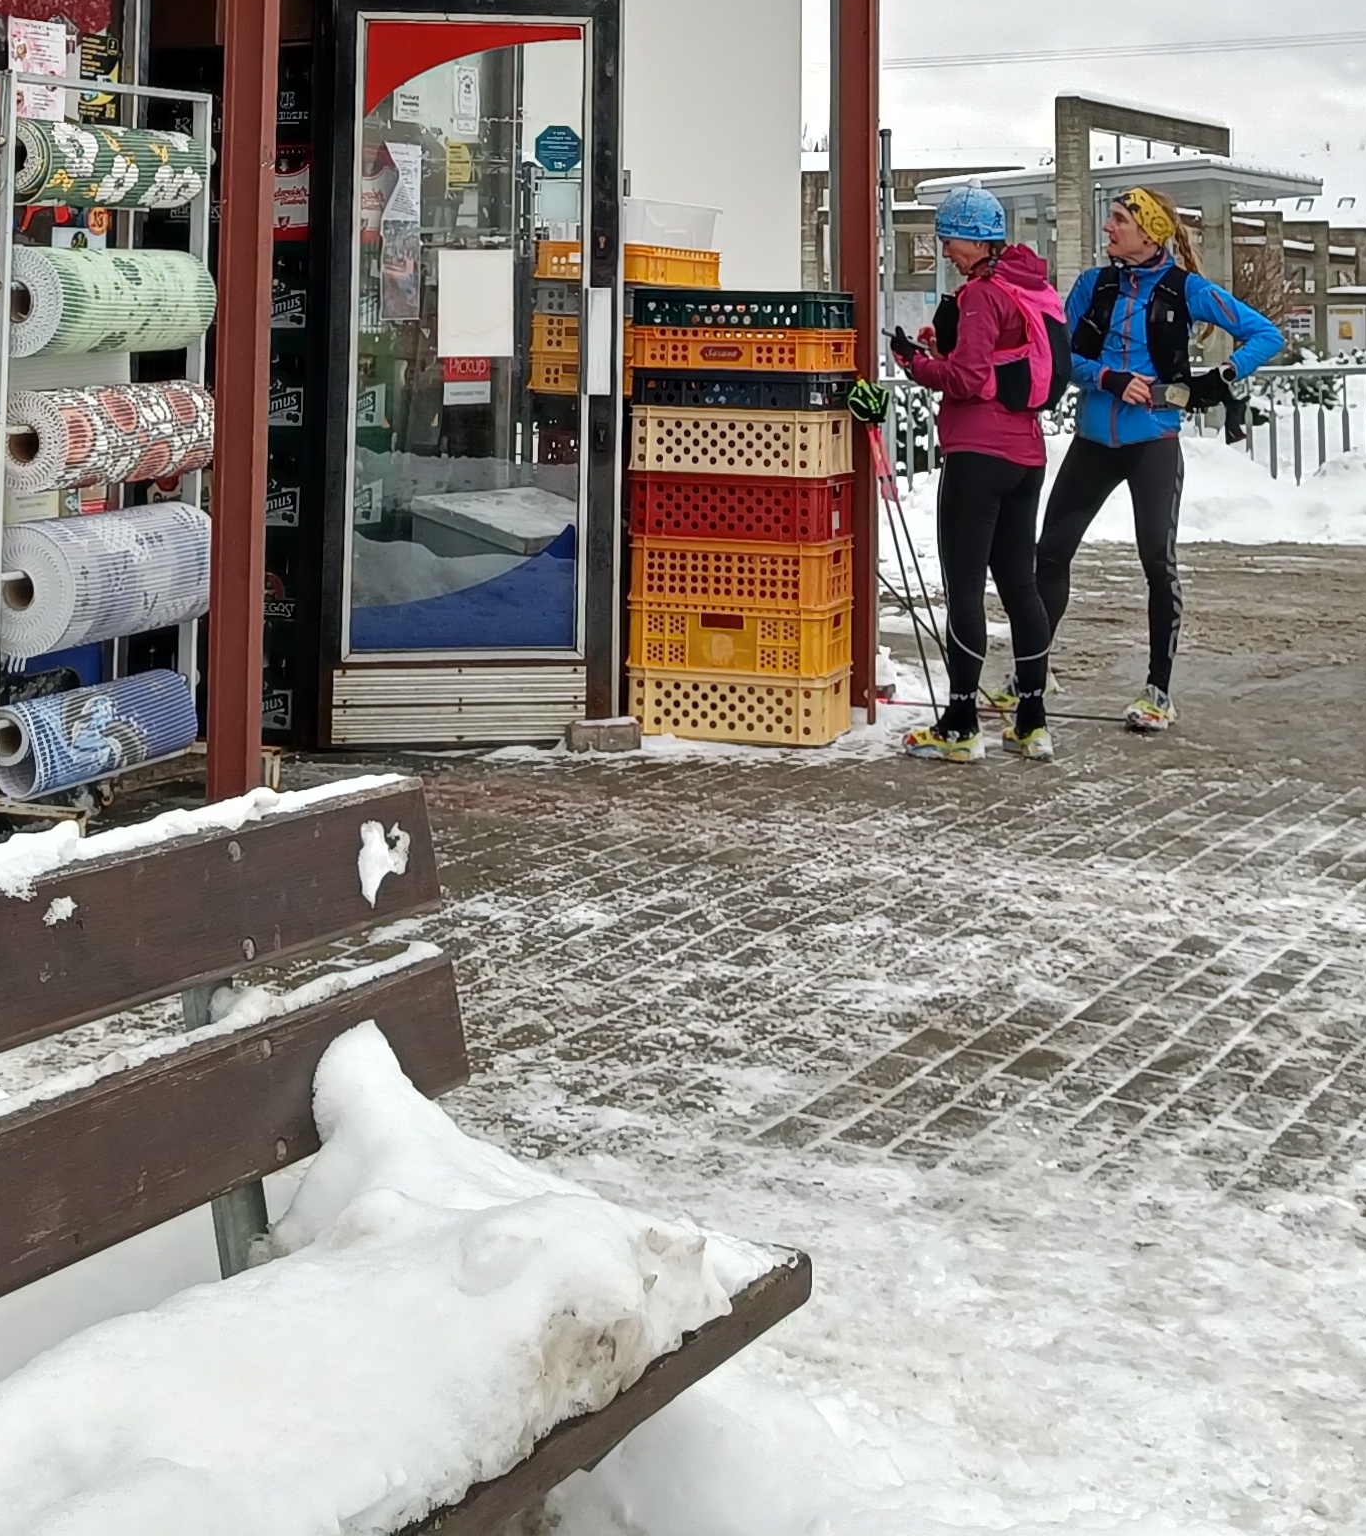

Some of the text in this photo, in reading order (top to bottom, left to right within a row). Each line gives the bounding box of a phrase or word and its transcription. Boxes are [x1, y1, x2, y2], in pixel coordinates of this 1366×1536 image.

[449, 357, 487, 378] Pickup
[269, 393, 298, 412] mus
[266, 492, 293, 511] mus
[263, 602, 296, 617] EGAST
